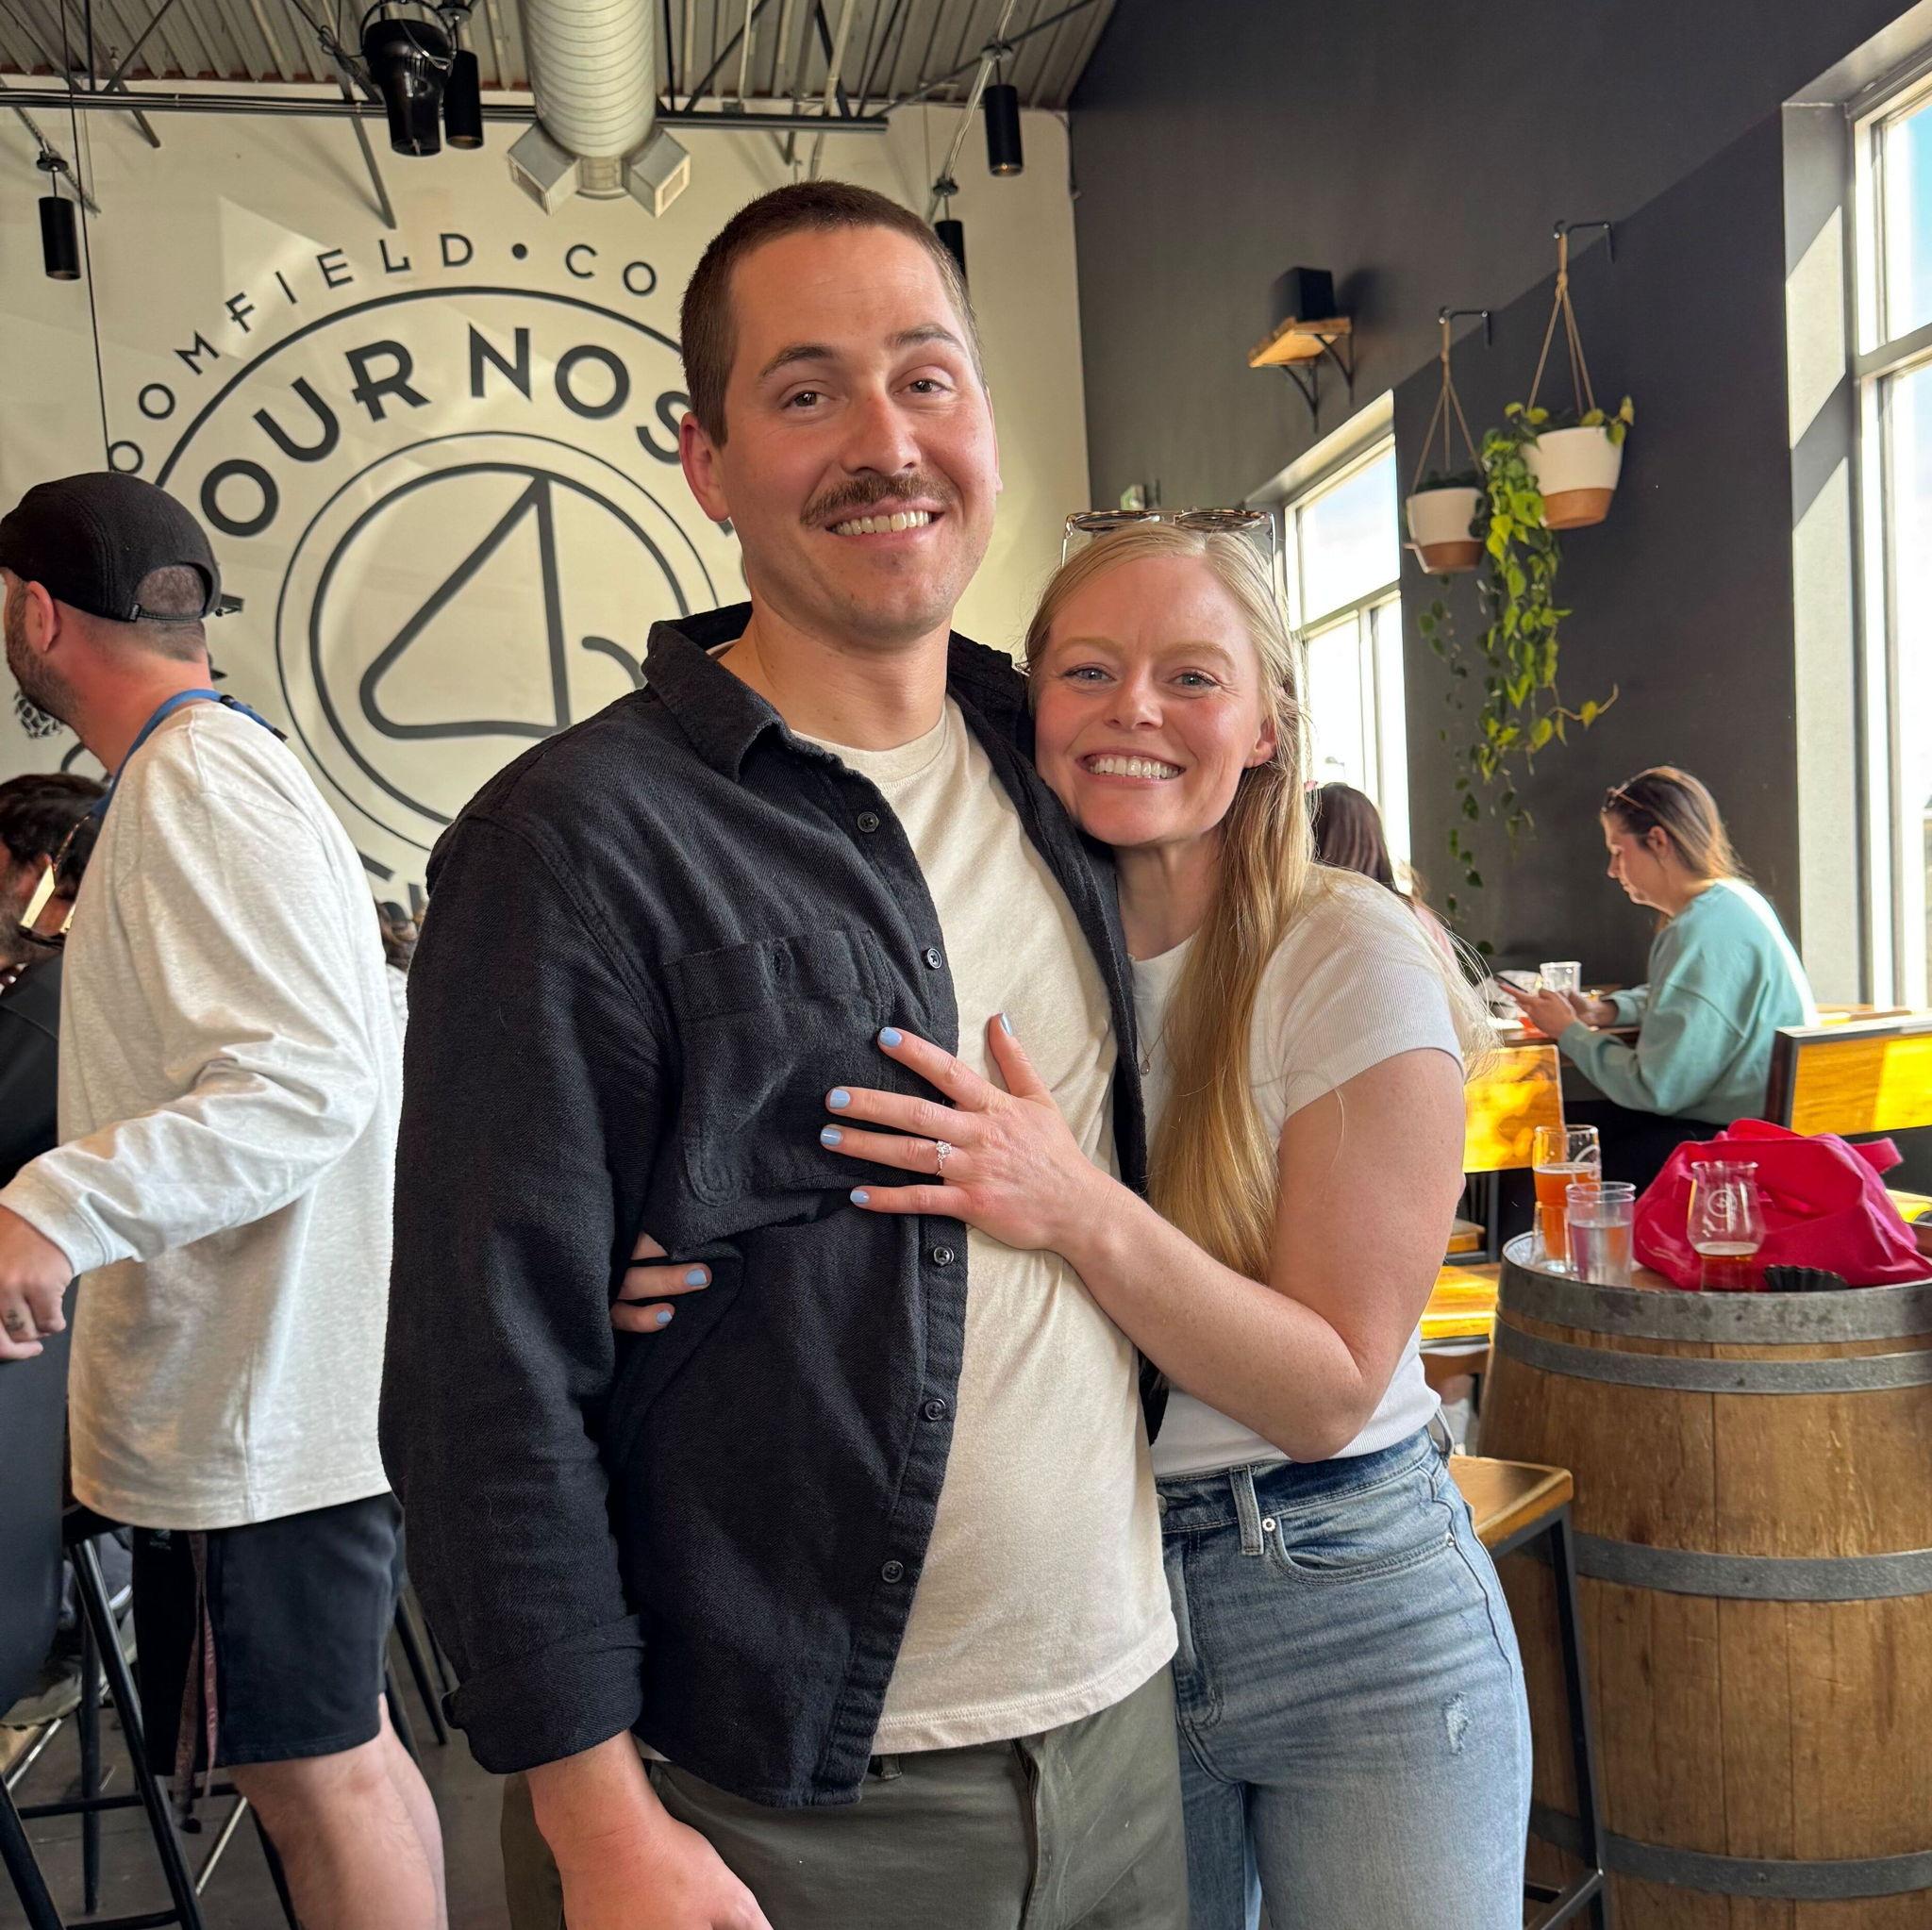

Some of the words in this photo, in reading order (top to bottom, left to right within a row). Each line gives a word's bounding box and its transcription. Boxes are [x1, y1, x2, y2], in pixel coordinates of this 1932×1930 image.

[107, 233, 474, 475] OOMFIELD
[564, 243, 658, 296] CO
[199, 340, 432, 540] OUR
[468, 324, 698, 466] NOS
